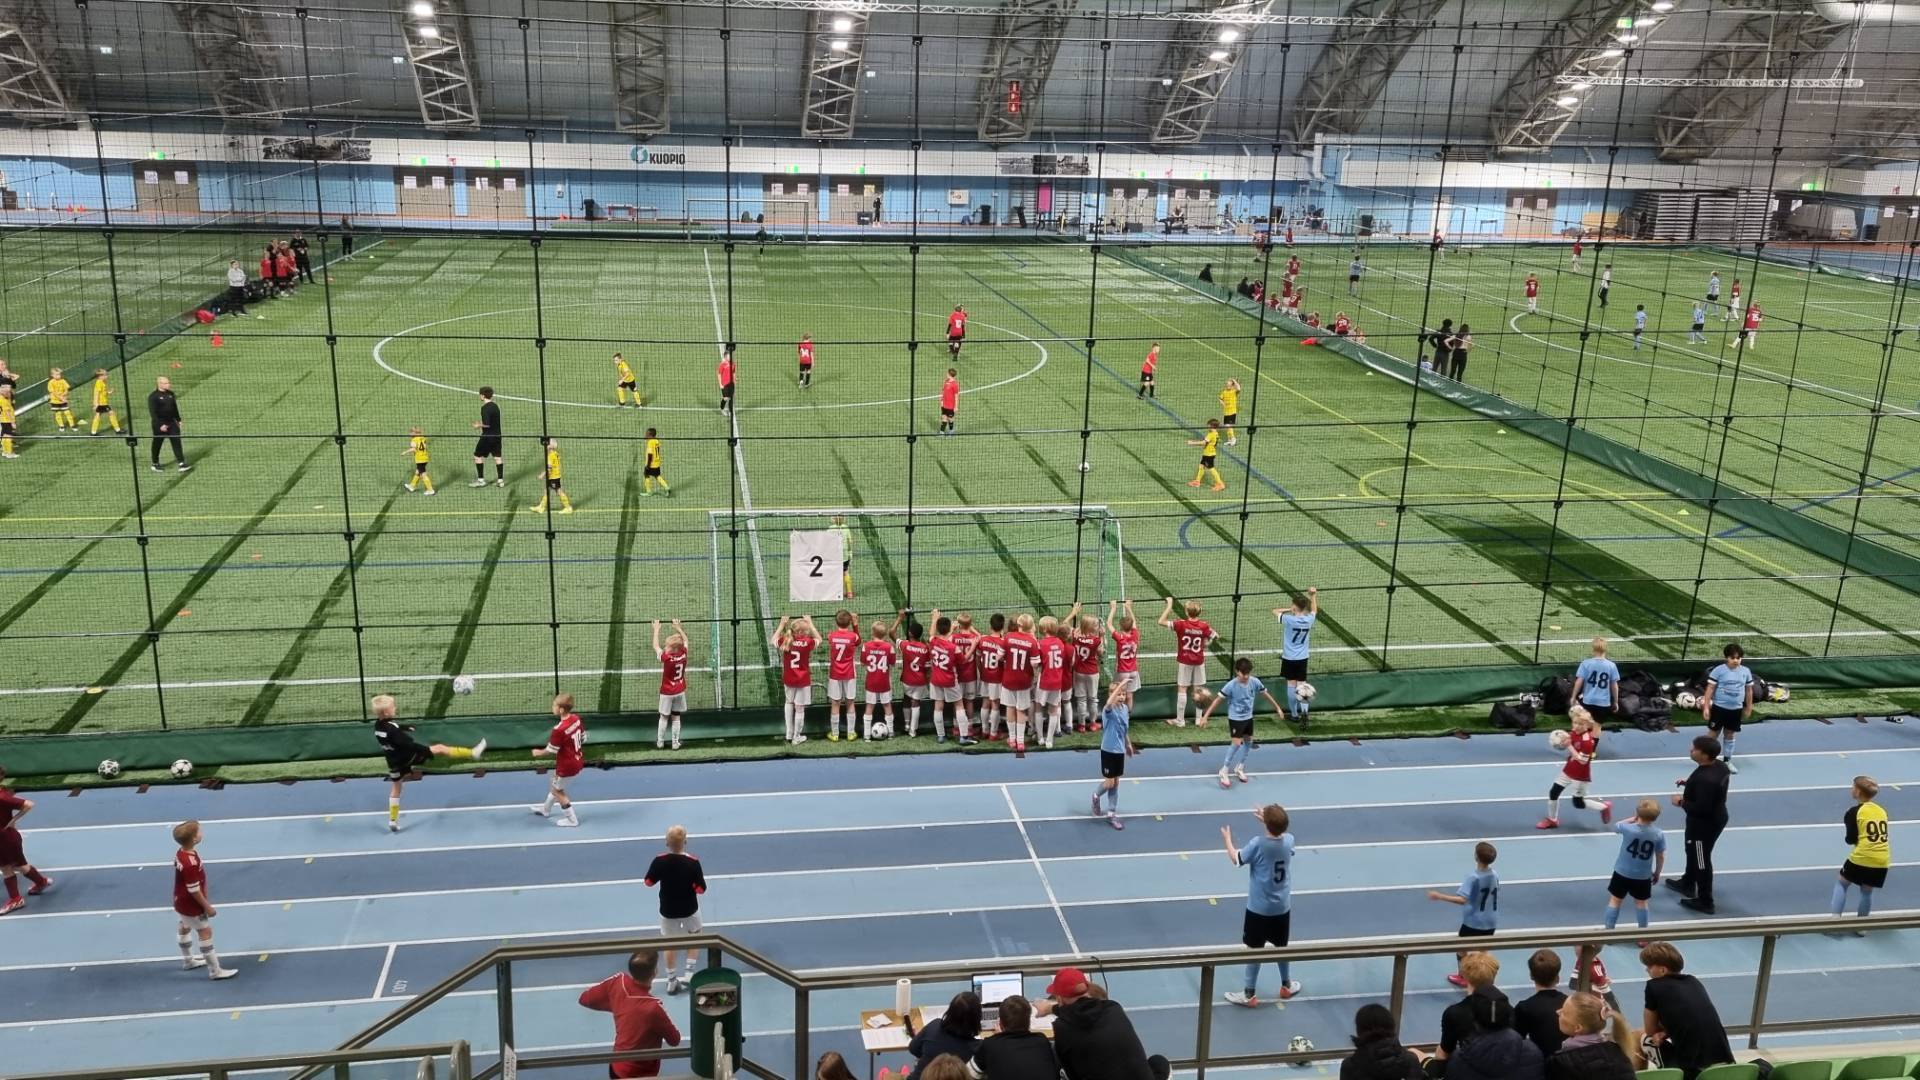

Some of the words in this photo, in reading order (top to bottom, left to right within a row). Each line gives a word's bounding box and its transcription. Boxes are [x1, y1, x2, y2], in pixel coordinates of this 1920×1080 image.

[649, 153, 686, 165] KUOPIO
[809, 555, 823, 577] 2
[1181, 635, 1202, 653] 28
[1292, 628, 1309, 644] 77
[790, 651, 801, 668] 2
[835, 643, 846, 661] 7
[931, 649, 950, 670] 32
[982, 650, 999, 669] 18
[1010, 648, 1028, 670] 11
[1047, 650, 1063, 669] 15
[673, 664, 684, 680] 3
[866, 655, 888, 672] 34
[910, 657, 920, 671] 6
[1587, 670, 1609, 689] 48
[1866, 820, 1888, 843] 99
[1626, 838, 1655, 860] 49
[1273, 860, 1286, 884] 5
[1480, 887, 1498, 912] 71
